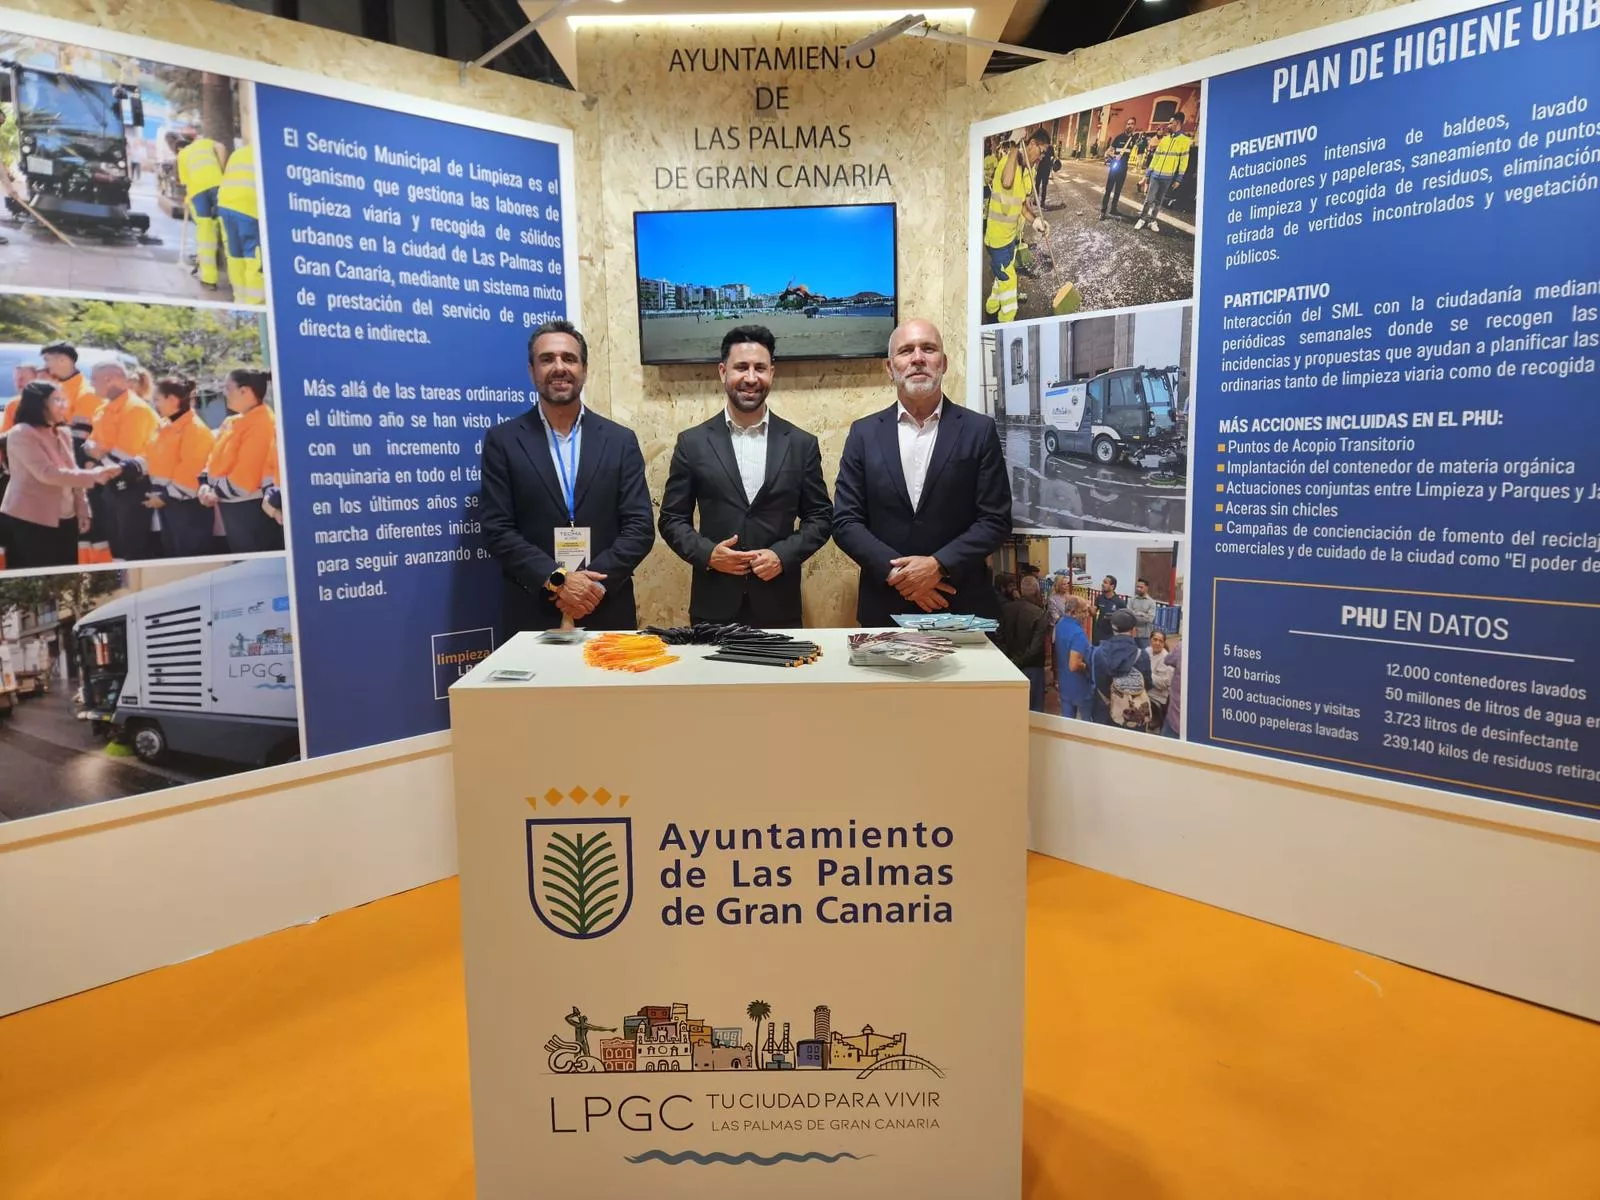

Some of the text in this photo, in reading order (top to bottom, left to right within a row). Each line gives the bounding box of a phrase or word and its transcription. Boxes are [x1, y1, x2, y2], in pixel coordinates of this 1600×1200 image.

[1273, 53, 1340, 103] PLAN
[1350, 42, 1384, 84] DE
[1394, 7, 1521, 74] HIGIENE
[756, 86, 789, 110] DE
[695, 125, 850, 150] LAS PALMAS
[1229, 96, 1587, 180] Actuaciones intensiva baldeos, lavado
[1231, 126, 1317, 158] PREVENTIVO
[284, 128, 522, 188] El Servicio Municipal Limpieza
[1229, 122, 1600, 201] contenedores papeleras, saneamiento puntos
[655, 163, 891, 189] DE GRAN CANARIA
[1250, 148, 1600, 220] limpieza recogida residuos, eliminación
[287, 165, 539, 218] organismo gestiona labores
[289, 192, 560, 248] limpieza viaria recogida sólidos
[1227, 173, 1598, 244] retirada vertidos incontrolados vegetación
[292, 226, 543, 272] urbanos ciudad Palmas
[1226, 249, 1279, 270] públicos.
[294, 256, 562, 301] Gran Canaria, mediante sistema mixto
[328, 294, 402, 312] prestación
[442, 304, 490, 320] servicio
[1224, 283, 1330, 308] PARTICIPATIVO
[1224, 289, 1521, 329] Interacción SML ciudadanía
[299, 318, 430, 344] directa indirecta.
[1223, 311, 1552, 354] periódicas semanales donde recogen
[1222, 333, 1568, 371] incidencias propuestas ayudan planificar
[1221, 356, 1595, 392] ordinarias tanto limpieza viaria recogida
[466, 386, 524, 402] ordinarias
[328, 409, 372, 427] último
[1219, 410, 1503, 433] MÁS ACCIONES INCLUIDAS EN EL PHU:
[387, 440, 460, 455] incremento
[1229, 437, 1415, 455] Puntos Acopio Transitorio
[311, 468, 390, 488] maquinaria
[1228, 458, 1574, 478] Implantación contenedor materia orgánica
[370, 495, 457, 512] últimos años
[1226, 481, 1301, 495] Actuaciones
[1305, 481, 1370, 499] conjuntas
[1416, 482, 1483, 500] Limpieza
[1502, 482, 1570, 502] Parques
[1226, 501, 1338, 517] Aceras chicles
[315, 523, 442, 543] marcha diferentes
[1227, 521, 1504, 544] Campañas concienciación fomento
[356, 552, 398, 572] seguir
[405, 546, 470, 565] avanzando
[1216, 542, 1577, 572] comerciales cuidado ciudad poder
[337, 580, 387, 599] ciudad.
[1342, 606, 1508, 640] PHU EN DATOS
[437, 650, 490, 665] limpieza
[1224, 644, 1261, 659] 5 fases
[229, 663, 283, 677] LPGC
[1223, 666, 1280, 684] 120 barrios
[1387, 664, 1586, 700] 12.000 contenedores lavados
[1223, 687, 1360, 718] 200 actuaciones visitas
[1385, 687, 1403, 701] 50
[1406, 691, 1460, 709] millones
[1486, 700, 1519, 717] litros
[1546, 711, 1581, 727] agua
[1222, 708, 1359, 741] 16.000 papeleras lavadas
[1384, 710, 1578, 751] 3.723 litros desinfectante
[1383, 734, 1552, 773] 239.140 kilos residuos
[659, 819, 954, 858] Ayuntamiento
[660, 857, 953, 889] de Las Palmas
[661, 896, 952, 925] de Gran Canaria
[886, 1092, 939, 1107] VIVIR
[550, 1095, 693, 1133] LPGC
[712, 1119, 939, 1132] LAS PALMAS DE GRAN CANARIA
